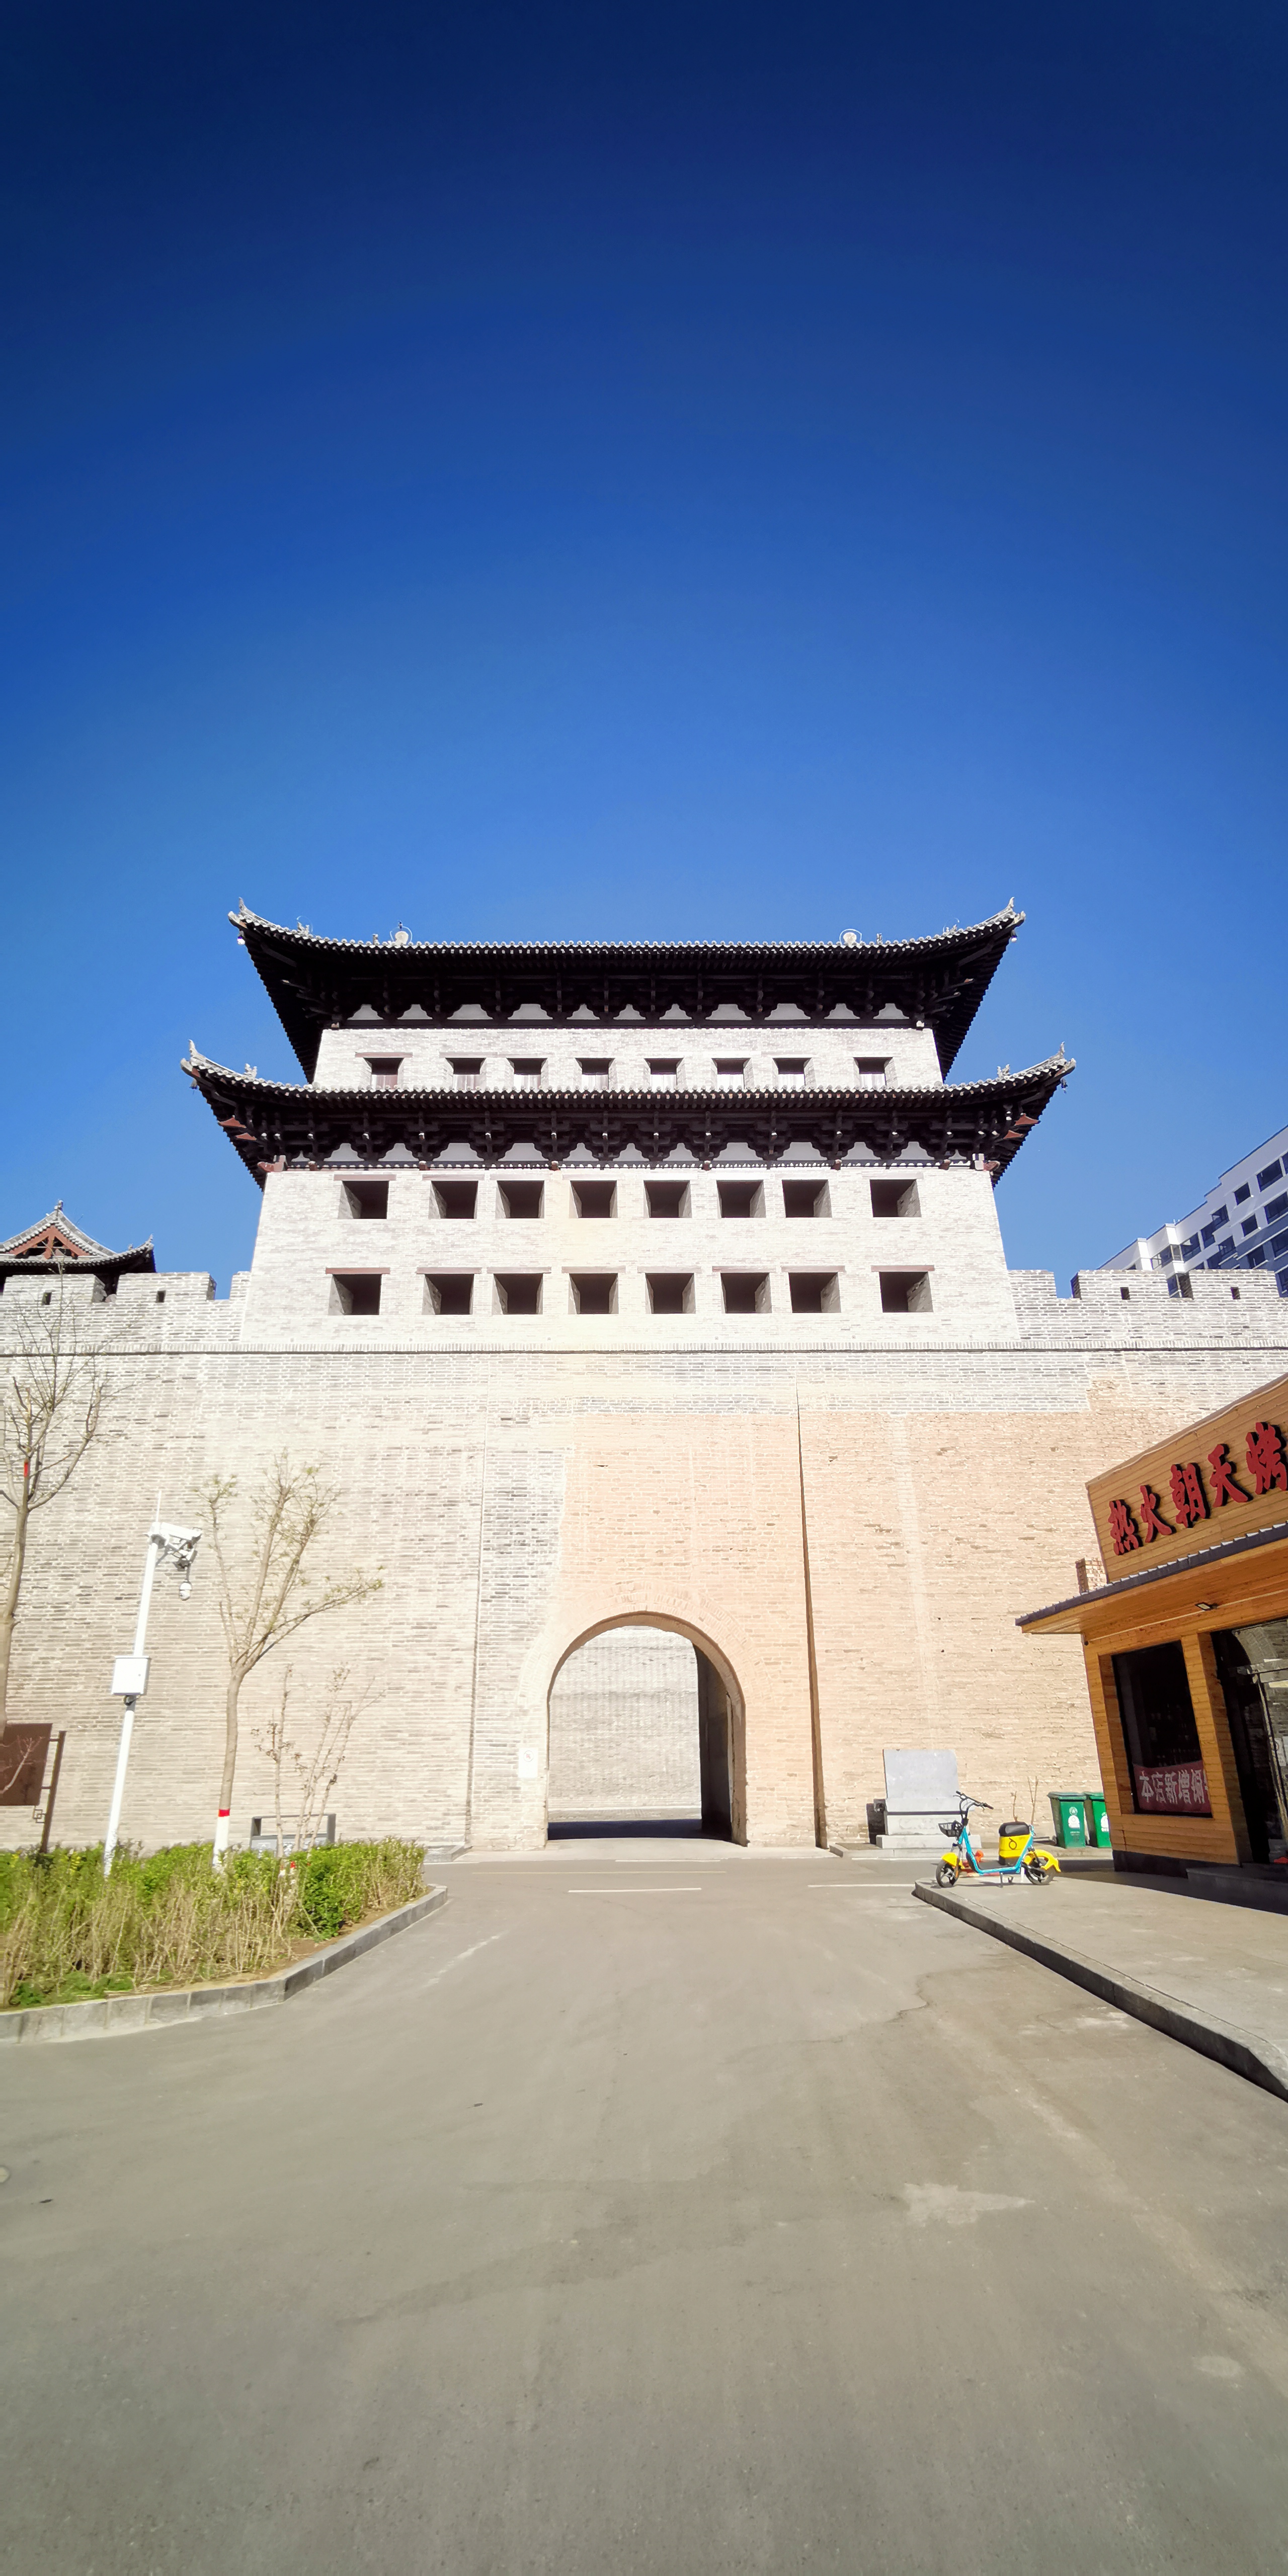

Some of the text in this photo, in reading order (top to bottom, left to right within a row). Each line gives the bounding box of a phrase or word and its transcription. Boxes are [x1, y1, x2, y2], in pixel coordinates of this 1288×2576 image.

[1108, 1422, 1287, 1555] 热火朝天烤
